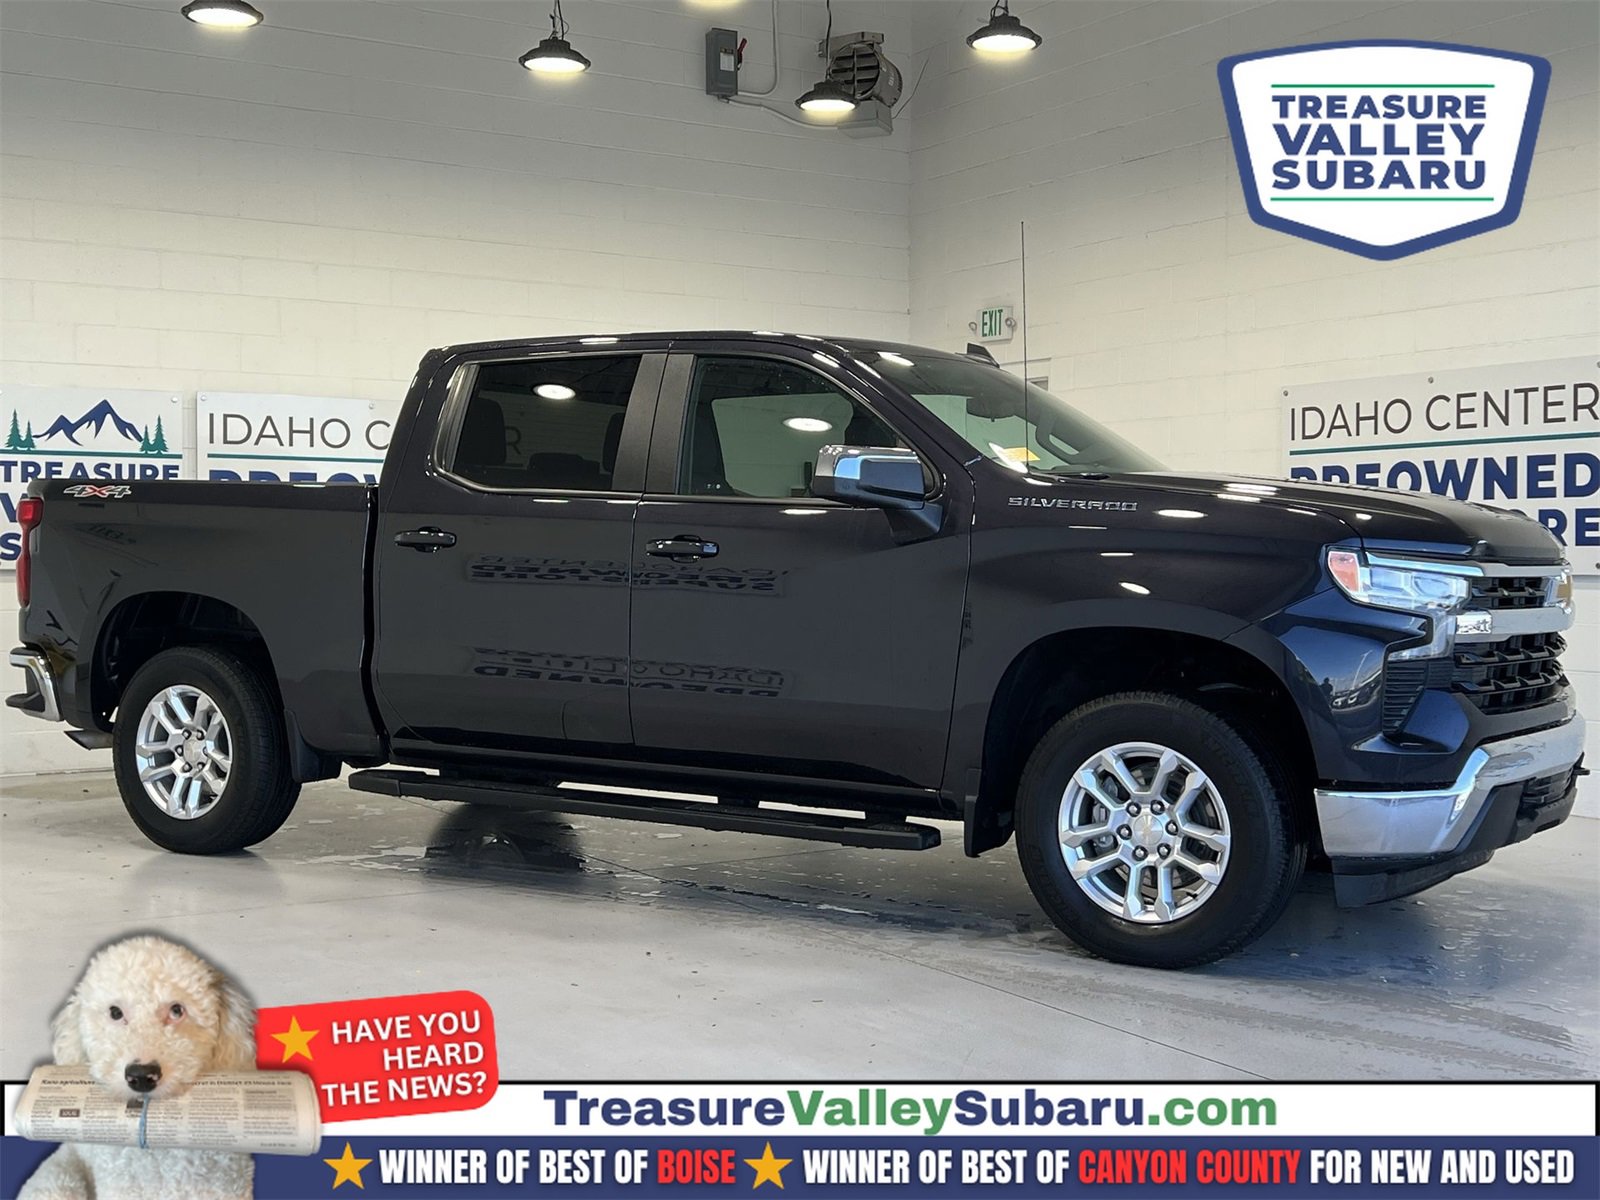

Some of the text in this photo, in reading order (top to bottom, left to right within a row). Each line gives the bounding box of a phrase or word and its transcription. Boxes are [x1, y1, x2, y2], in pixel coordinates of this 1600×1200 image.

[982, 309, 1003, 337] EXIT
[1291, 382, 1600, 441] IDAHO CENTER
[208, 413, 351, 449] IDAHO
[1008, 497, 1137, 511] SILVERADO
